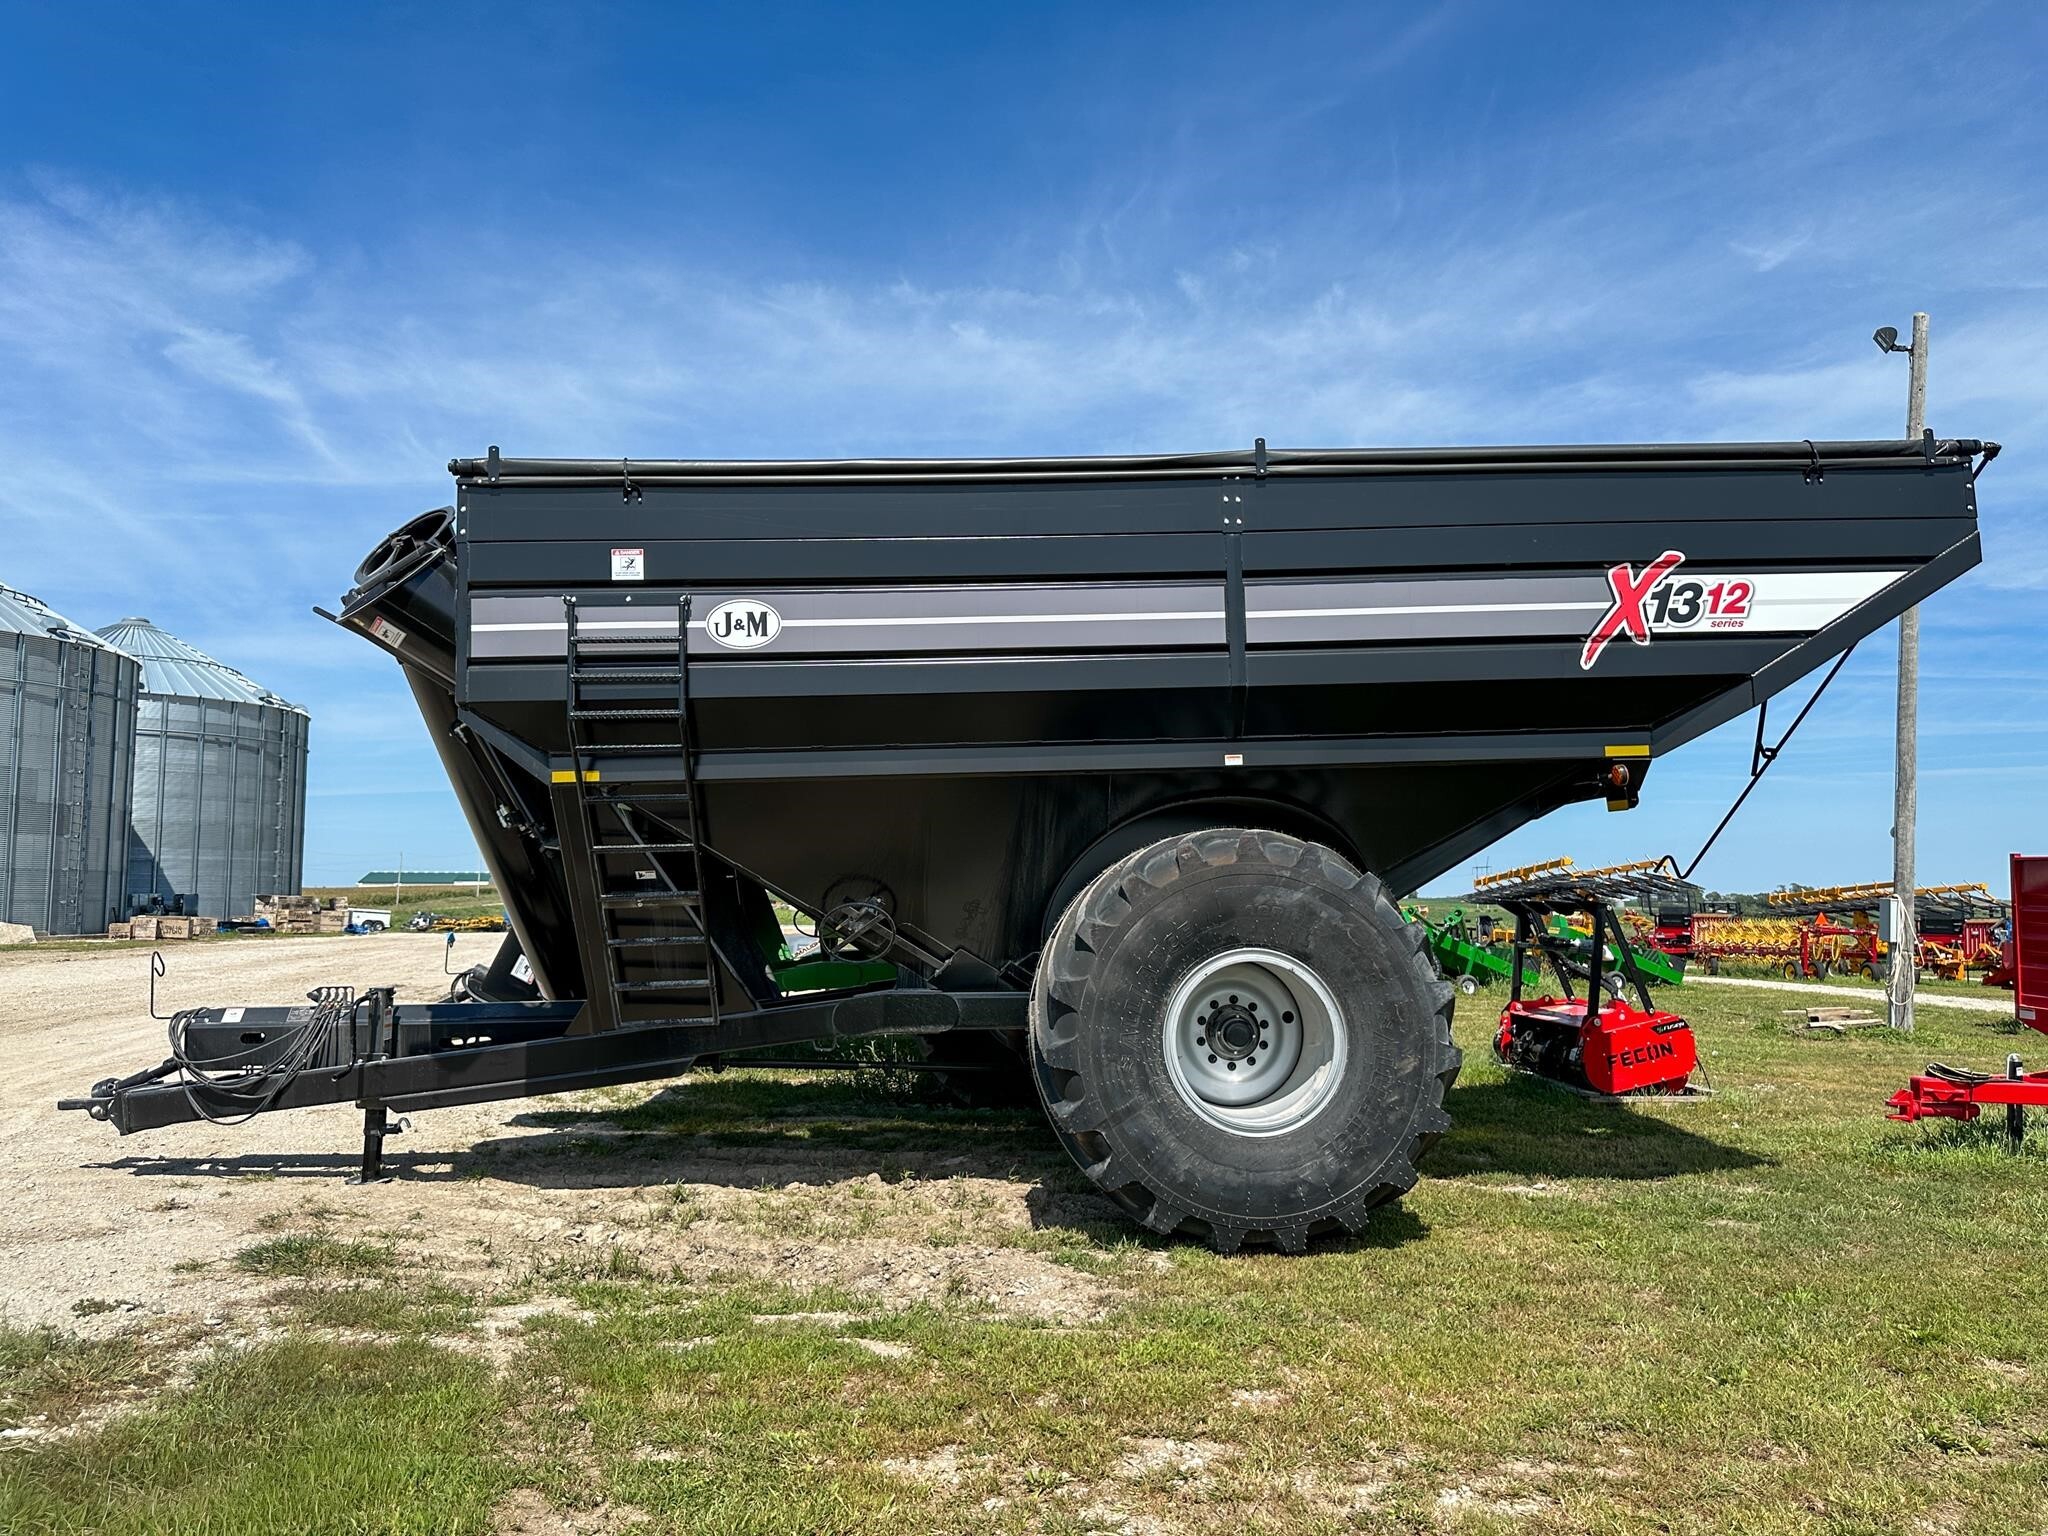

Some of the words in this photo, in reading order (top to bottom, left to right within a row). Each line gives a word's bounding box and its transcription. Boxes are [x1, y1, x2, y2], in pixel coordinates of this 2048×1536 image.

[714, 611, 768, 638] J&M
[1710, 618, 1744, 628] series
[1607, 1041, 1673, 1072] FECON
